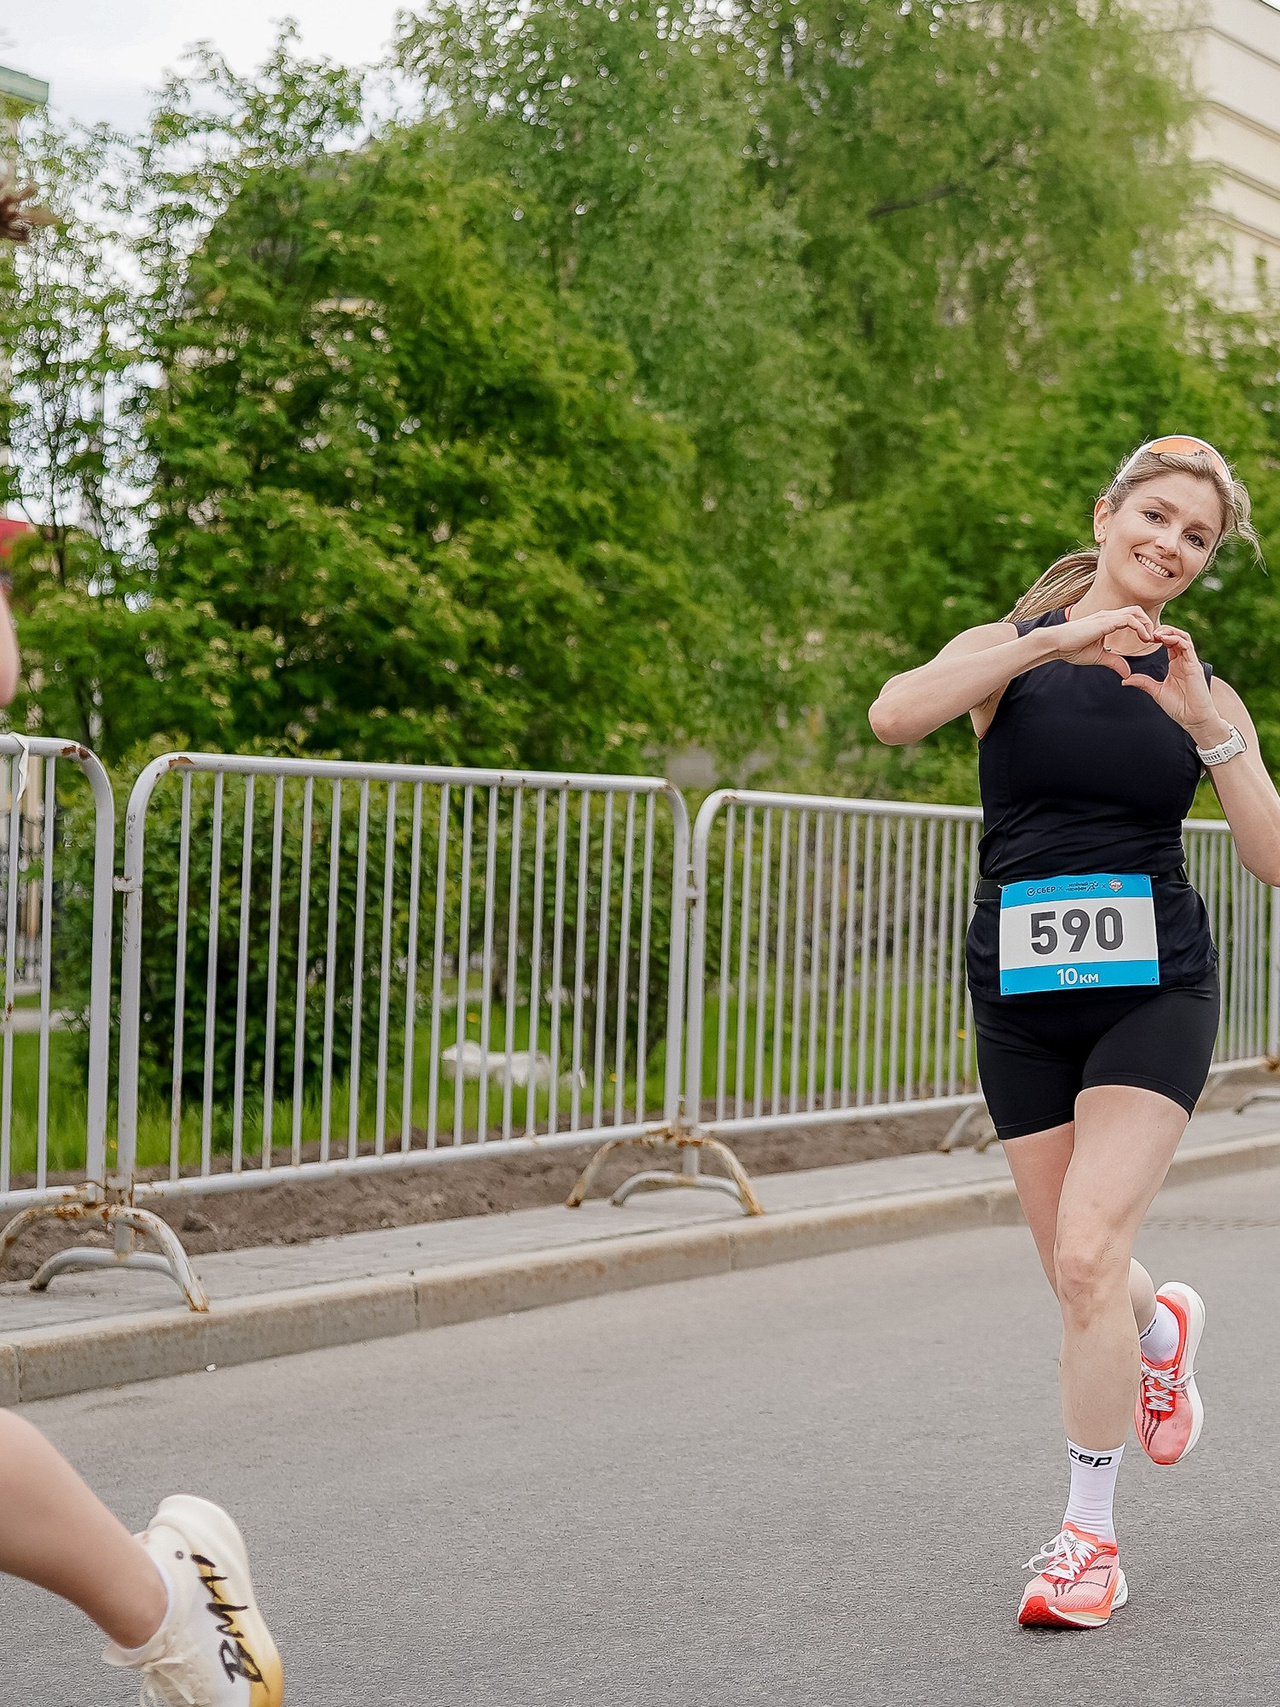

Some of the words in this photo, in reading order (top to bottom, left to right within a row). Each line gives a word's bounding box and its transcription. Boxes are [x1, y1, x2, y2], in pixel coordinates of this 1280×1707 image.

[1036, 885, 1056, 894] СБЕР
[1030, 907, 1124, 955] 590
[1069, 1448, 1113, 1467] cep
